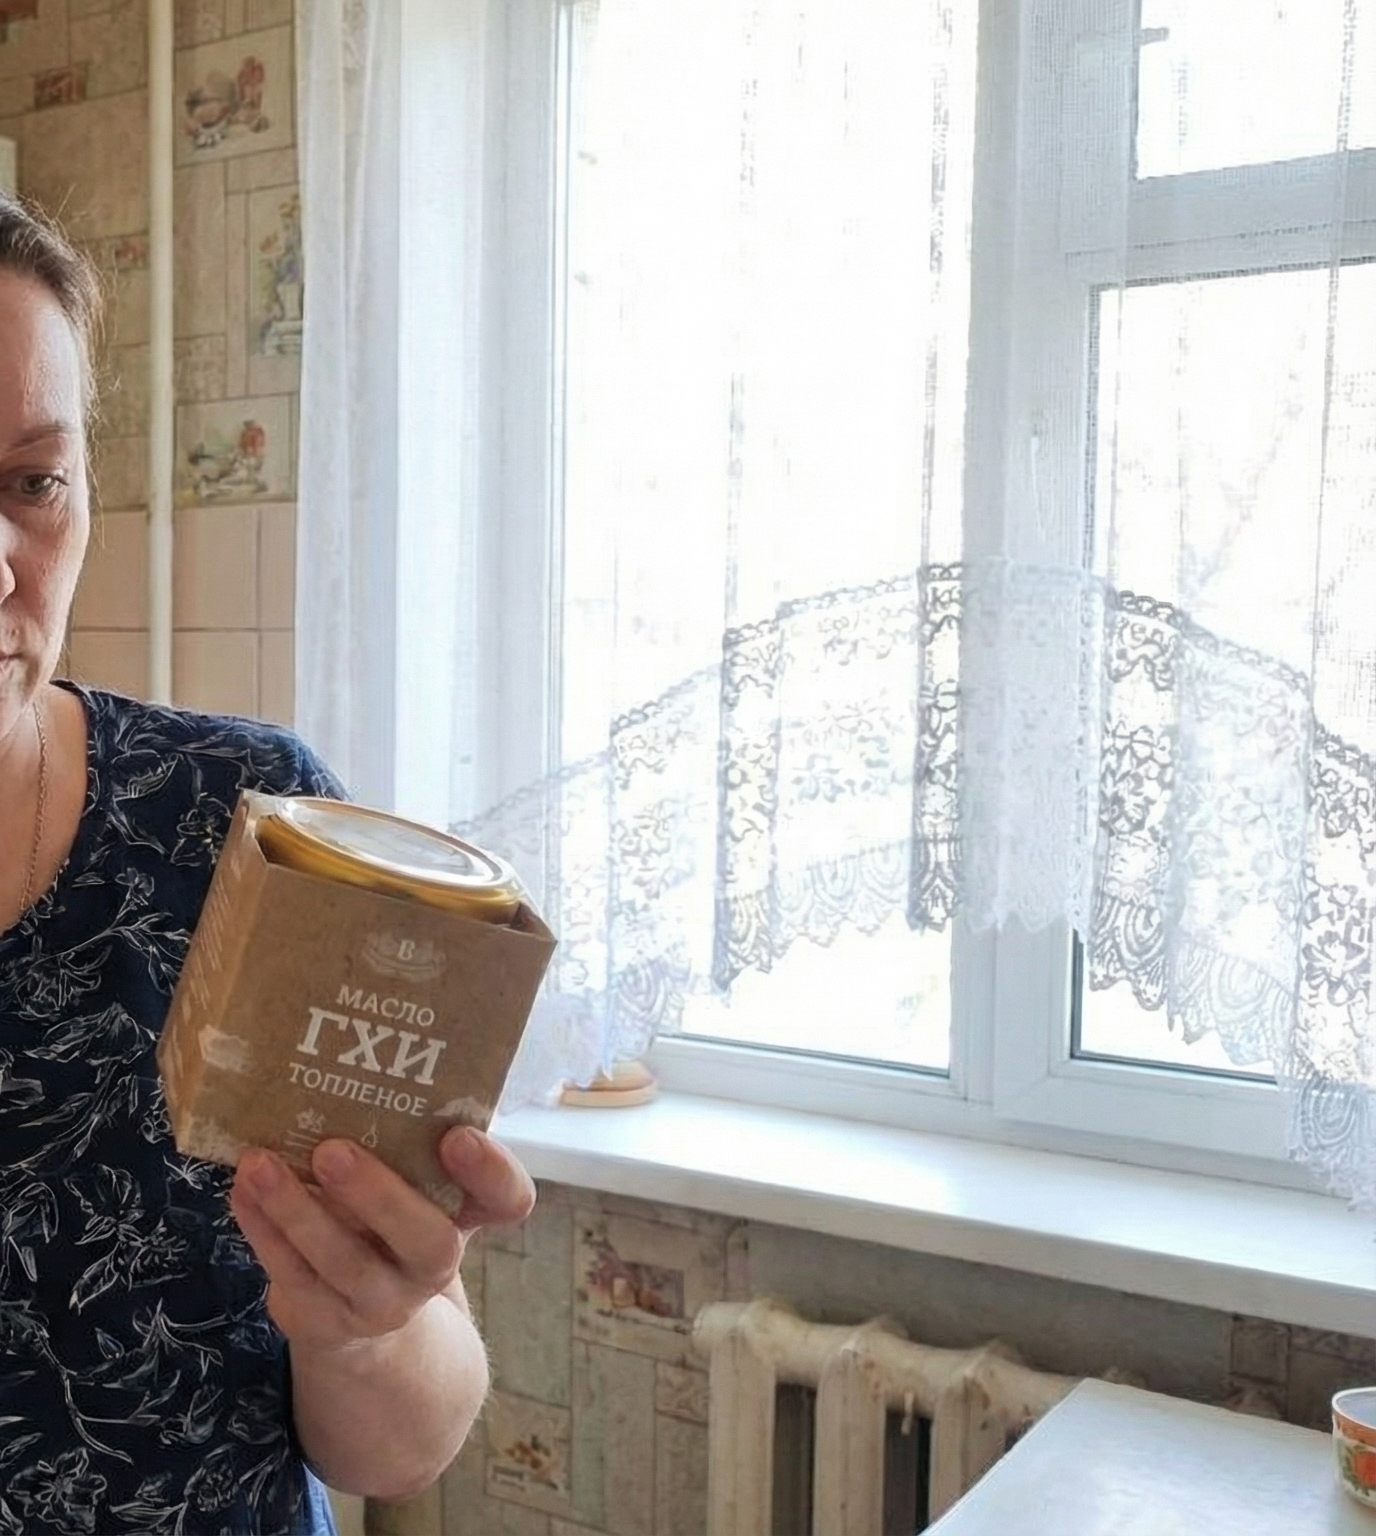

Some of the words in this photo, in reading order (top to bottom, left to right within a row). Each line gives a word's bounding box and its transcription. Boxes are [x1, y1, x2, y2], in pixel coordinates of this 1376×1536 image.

[336, 985, 436, 1027] МАСЛО
[296, 1006, 447, 1086] ГХИ
[288, 1062, 428, 1118] ТОПЛЕНОЕ
